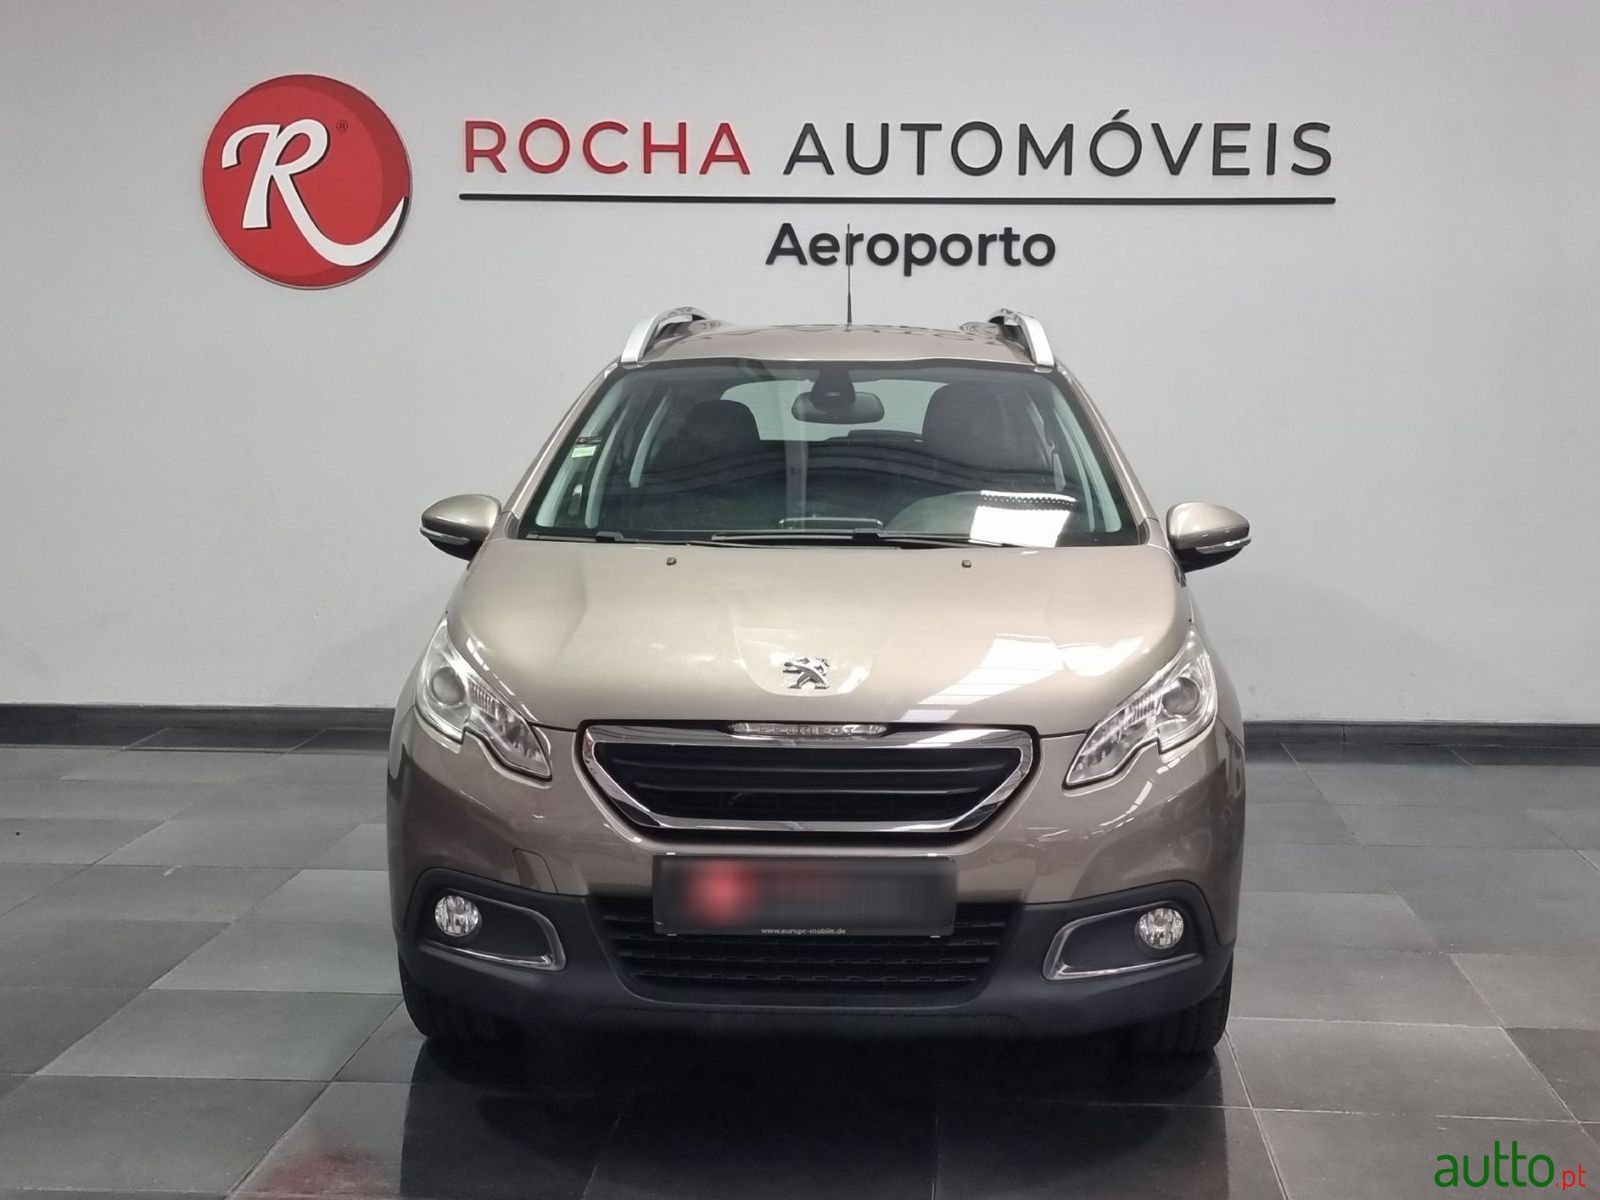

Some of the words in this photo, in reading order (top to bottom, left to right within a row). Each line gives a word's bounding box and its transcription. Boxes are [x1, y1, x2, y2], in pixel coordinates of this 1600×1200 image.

[464, 118, 751, 175] ROCHA
[782, 109, 1333, 177] AUTOMÓVEIS
[220, 118, 409, 267] R
[765, 222, 1057, 277] Aeroporto
